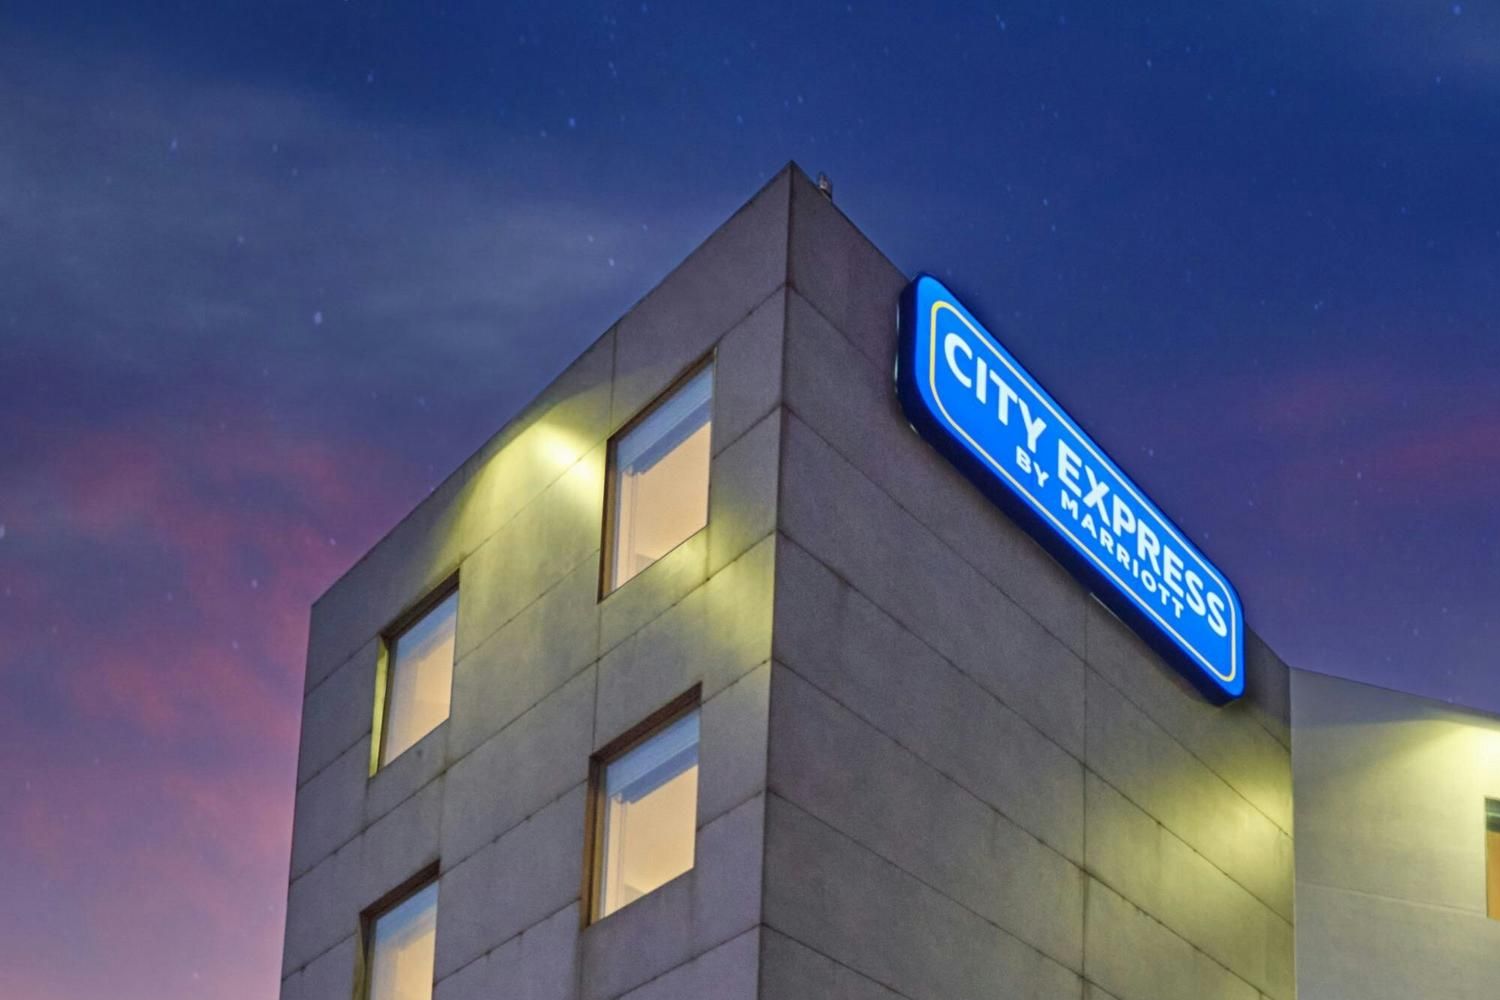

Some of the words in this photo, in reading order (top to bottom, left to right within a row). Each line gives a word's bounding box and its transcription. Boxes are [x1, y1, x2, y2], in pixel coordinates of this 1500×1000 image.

[944, 333, 1046, 453] CITY
[1057, 439, 1227, 637] EXPRESS
[1016, 446, 1049, 488] BY
[1061, 489, 1184, 619] MARRIOTT
